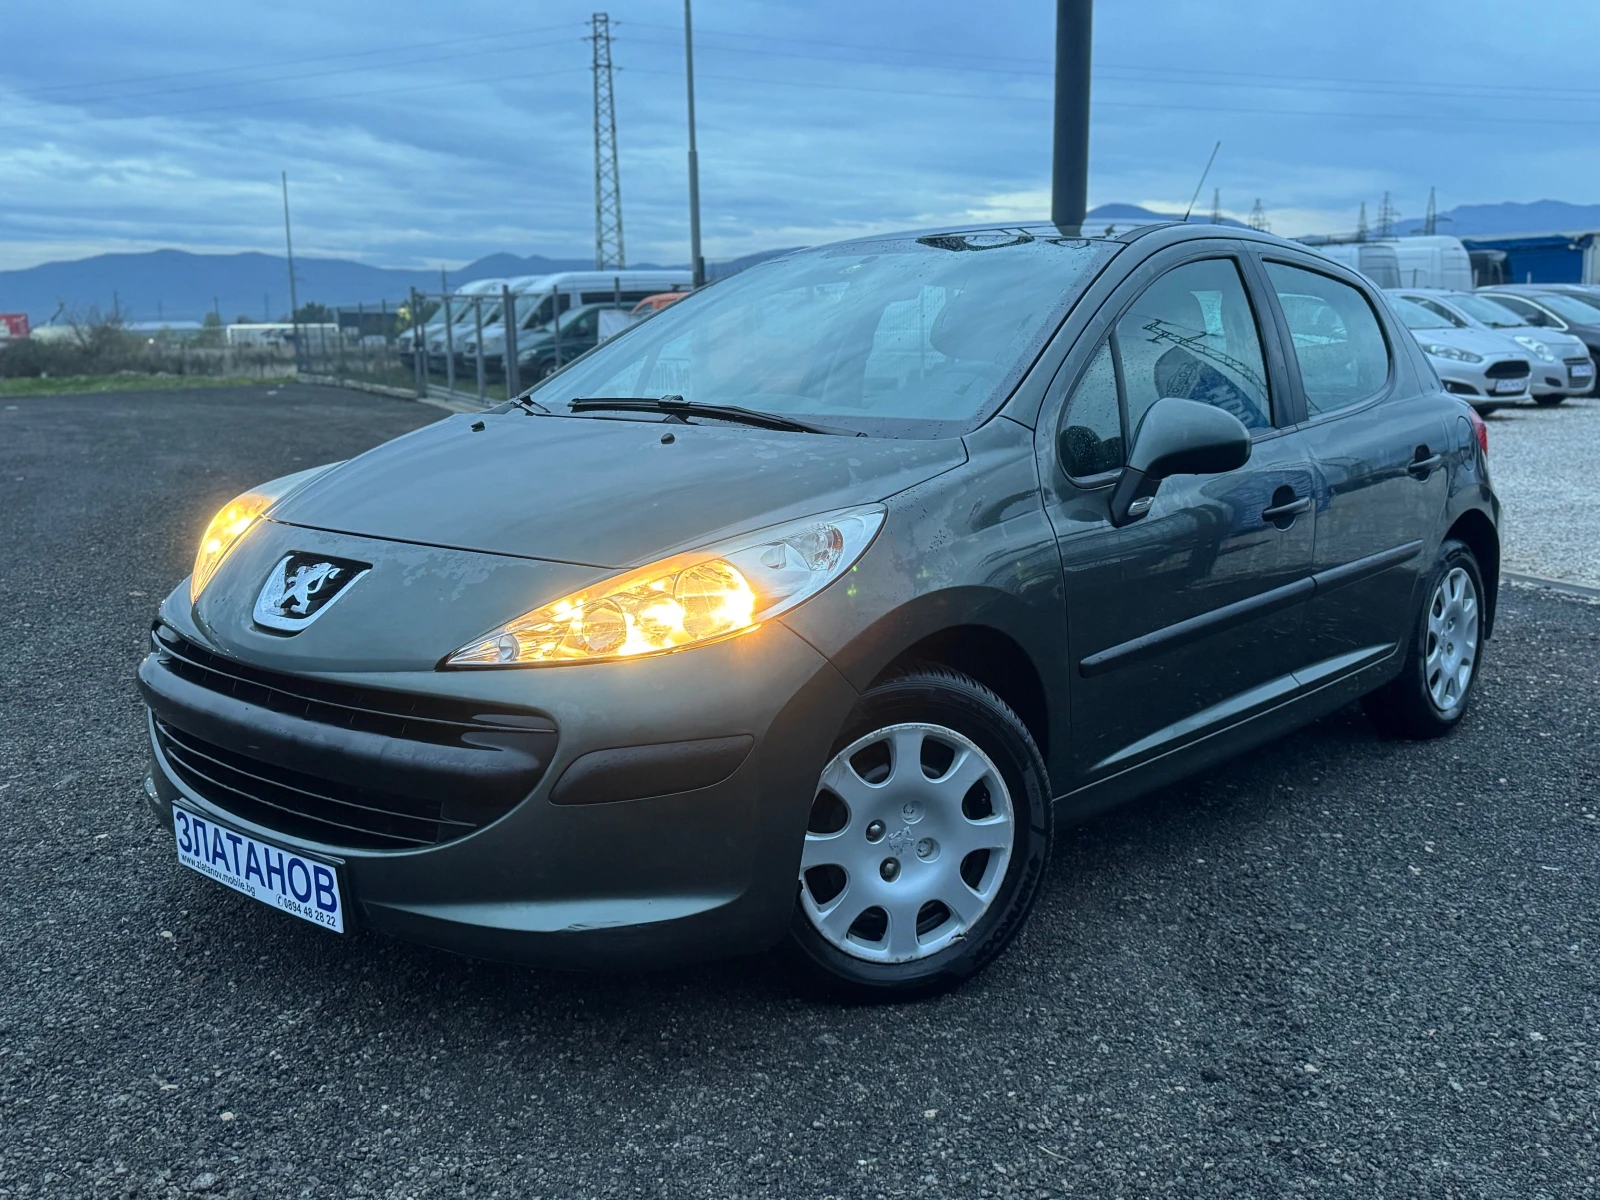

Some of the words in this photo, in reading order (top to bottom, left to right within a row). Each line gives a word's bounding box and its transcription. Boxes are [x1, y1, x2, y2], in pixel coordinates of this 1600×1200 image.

[176, 811, 337, 913] ЗЛАТАНОВ
[181, 854, 256, 897] www.zlatanov.mobile.bg
[284, 900, 302, 914] 0894
[303, 905, 313, 918] 48
[315, 910, 325, 923] 28
[326, 914, 337, 928] 22
